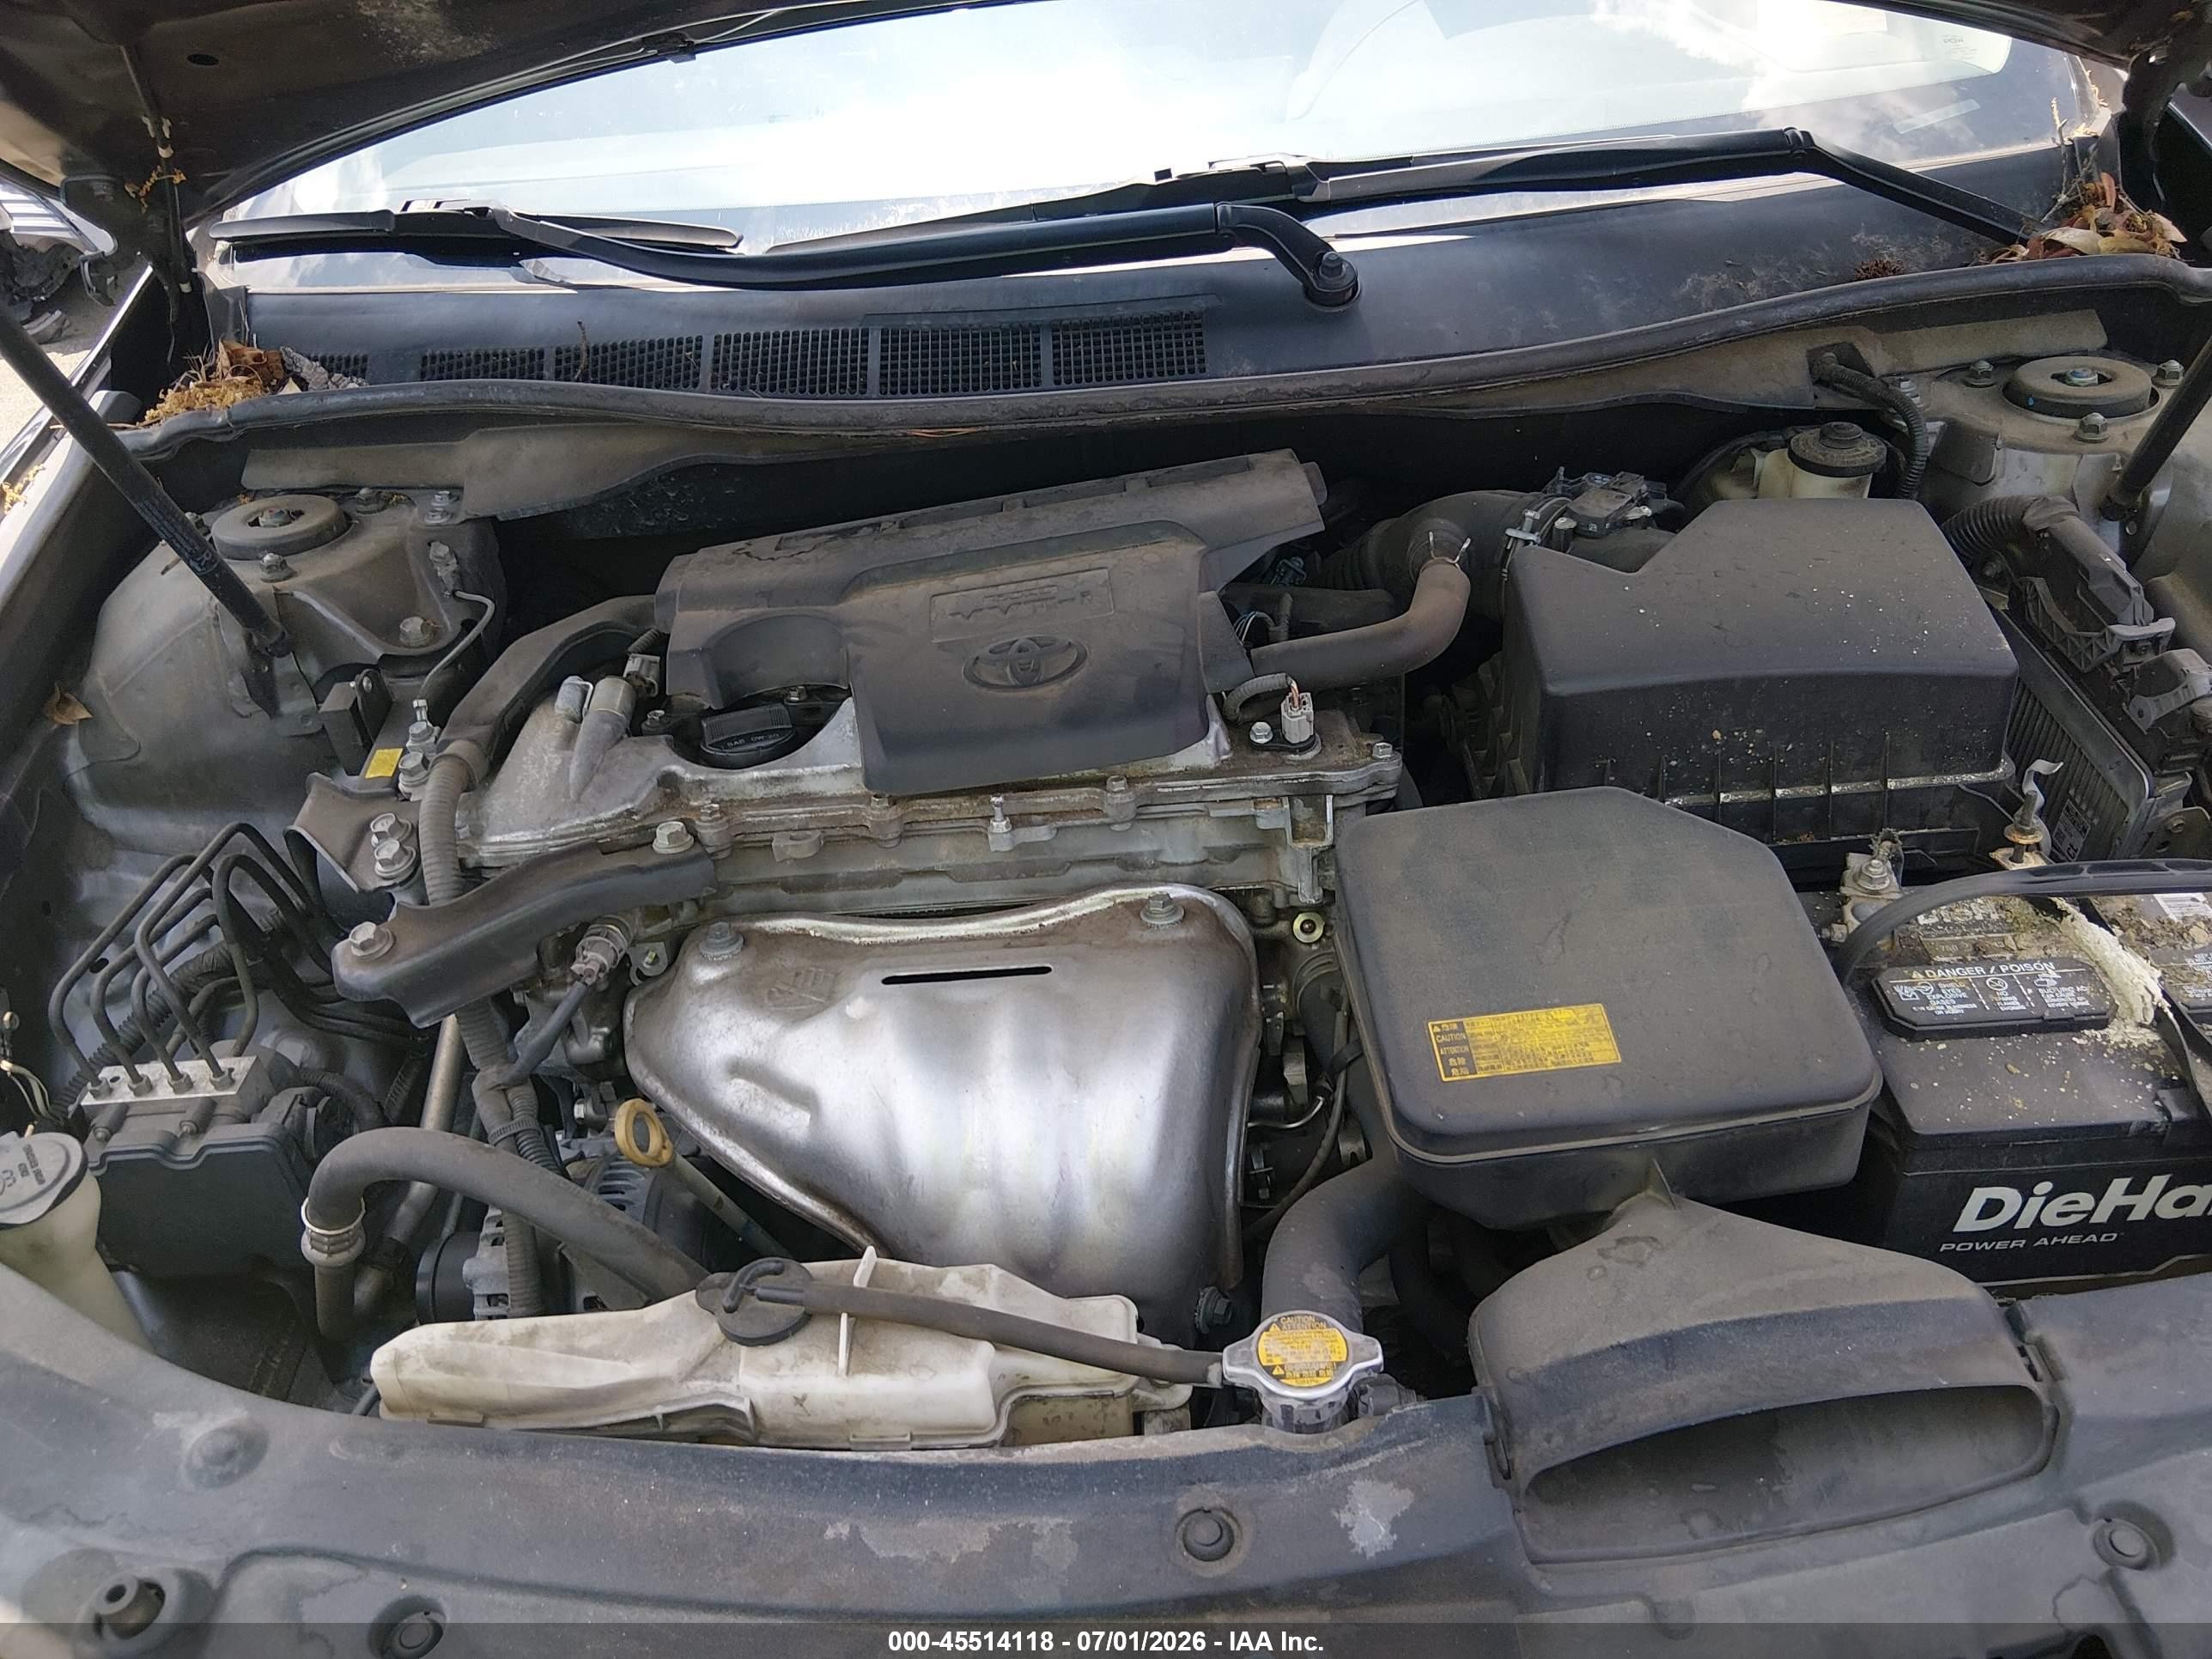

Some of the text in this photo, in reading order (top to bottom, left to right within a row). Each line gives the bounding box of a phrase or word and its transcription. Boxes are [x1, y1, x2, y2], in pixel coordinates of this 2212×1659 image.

[1926, 965, 1985, 978] DANGER
[1999, 961, 2056, 974] POISON
[1436, 1032, 1467, 1043] CAUTION
[1953, 1174, 2212, 1232] DieHa
[1939, 1232, 2118, 1252] POWER AHEAD
[1281, 1322, 1327, 1331] ATTENTION
